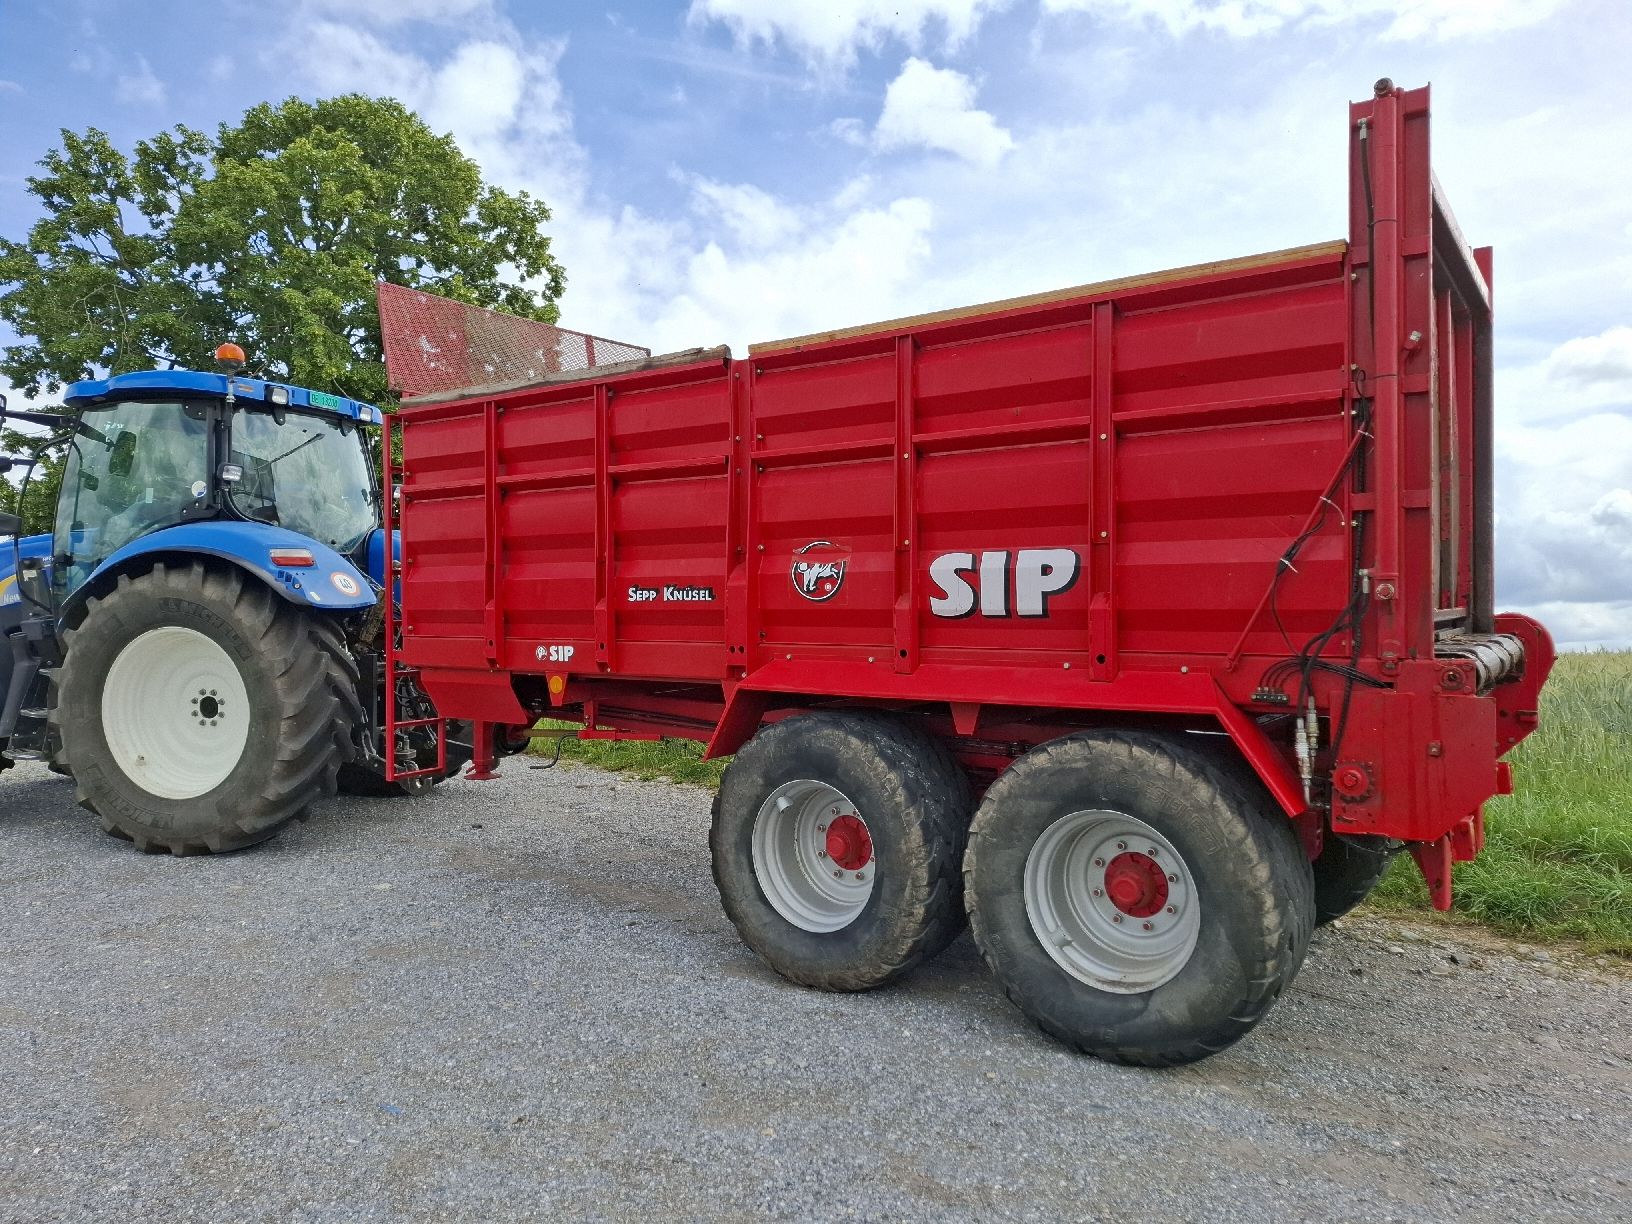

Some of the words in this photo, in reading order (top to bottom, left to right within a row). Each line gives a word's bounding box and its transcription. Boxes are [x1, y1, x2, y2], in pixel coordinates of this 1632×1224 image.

[339, 578, 353, 589] 40
[929, 548, 1080, 619] SIP
[549, 645, 574, 662] SIP
